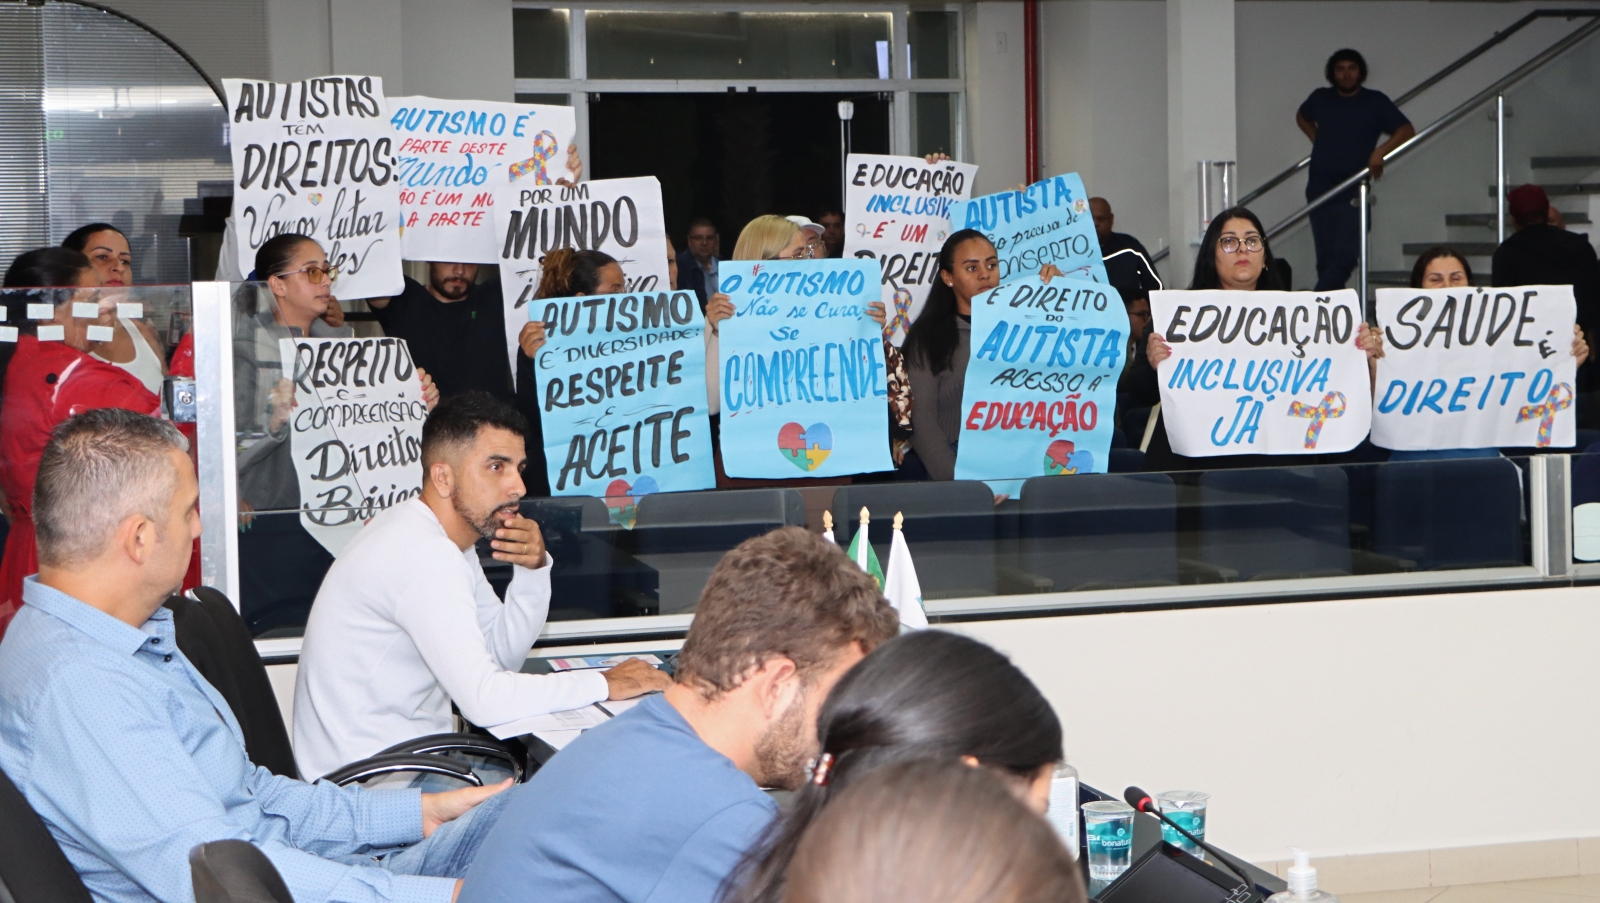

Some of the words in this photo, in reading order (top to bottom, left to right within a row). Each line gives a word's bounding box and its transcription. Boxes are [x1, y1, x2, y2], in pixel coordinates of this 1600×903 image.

[282, 120, 325, 136] TÊM
[390, 107, 506, 136] AUTISMO
[513, 111, 536, 137] É
[399, 138, 452, 154] PARTE
[459, 142, 507, 155] DESTE
[240, 137, 399, 196] DIREITOS:
[852, 163, 965, 196] EDUCAÇÃO
[435, 192, 463, 206] UM
[520, 188, 553, 207] POR
[560, 183, 589, 201] UM
[865, 194, 958, 220] INCLUSIV
[965, 176, 1073, 231] AUTISTA
[243, 193, 322, 250] Vamos
[325, 187, 388, 241] lutar
[427, 211, 486, 227] PARTE
[502, 195, 638, 260] MUNDO
[900, 223, 929, 244] UM
[720, 274, 743, 293] O
[1009, 284, 1108, 313] DIREITO
[542, 292, 693, 338] AUTISMO
[736, 296, 780, 317] Não
[1045, 314, 1064, 322] DO
[1385, 286, 1538, 350] SAÚDE
[563, 328, 700, 363] DIVERSIDADE:
[976, 320, 1122, 369] AUTISTA
[1166, 296, 1353, 359] EDUCAÇÃO
[294, 338, 413, 394] RESPEITO
[544, 350, 684, 412] RESPEITE
[724, 337, 889, 412] COMPREENDE
[990, 368, 1085, 393] ACESSO
[1168, 358, 1332, 396] INCLUSIVA
[1378, 368, 1553, 416] DIREITO
[965, 393, 1098, 437] EDUCAÇÃO
[1210, 395, 1276, 447] JÁ
[556, 406, 695, 490] ACEITE
